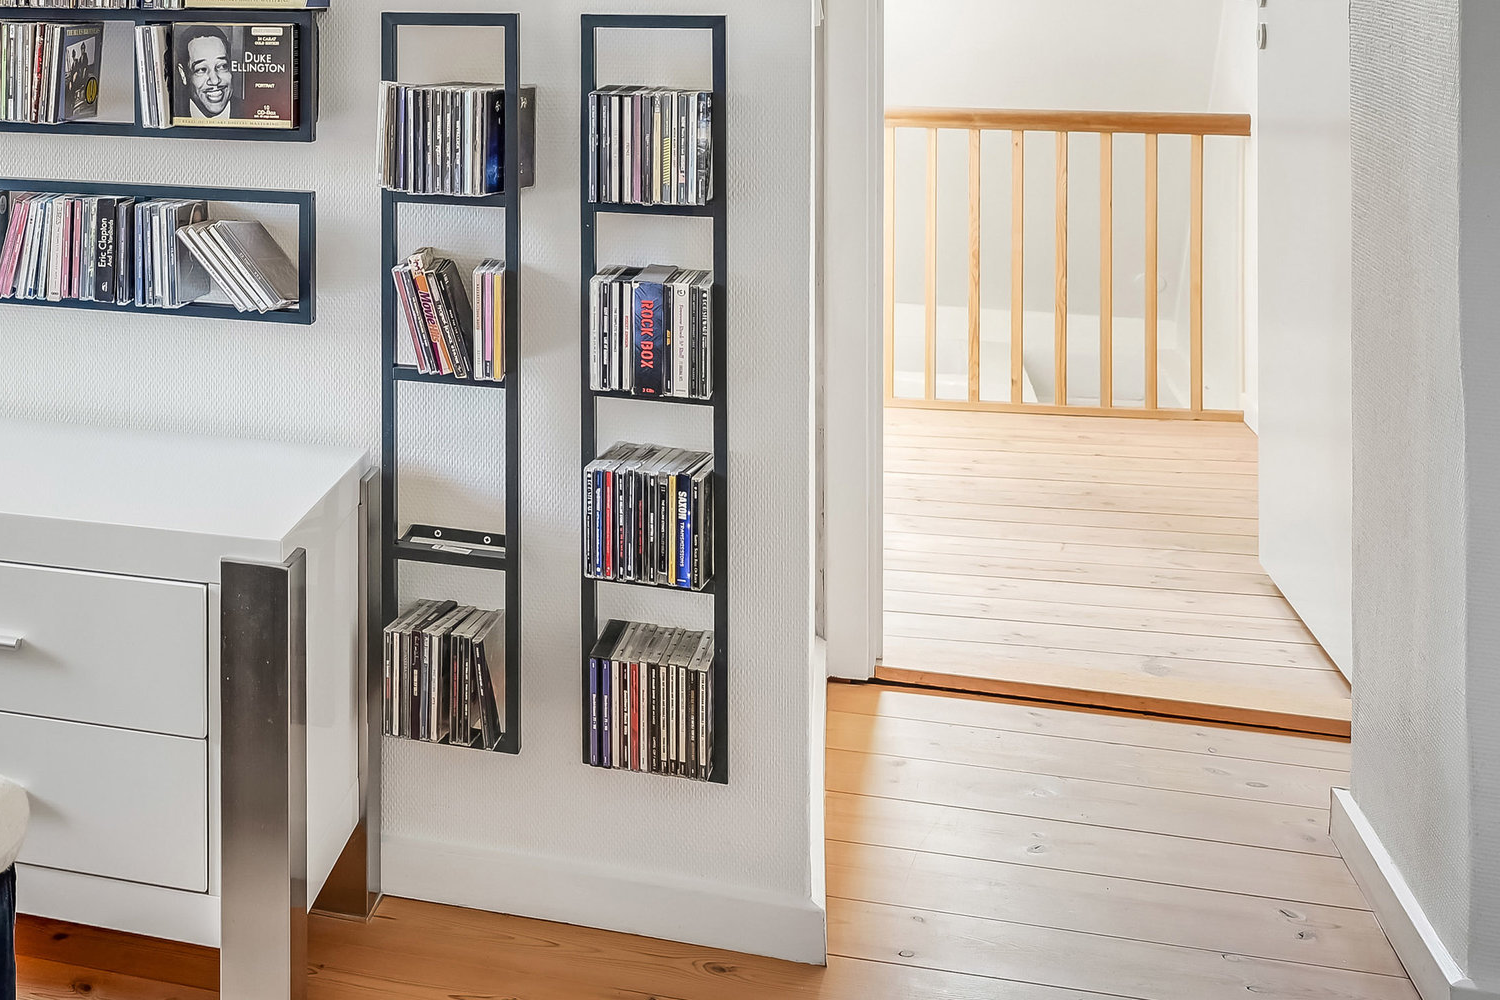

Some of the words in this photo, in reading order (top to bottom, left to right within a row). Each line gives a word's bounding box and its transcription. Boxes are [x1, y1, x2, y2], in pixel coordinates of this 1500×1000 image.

[231, 60, 285, 73] ELLINGTON
[244, 51, 271, 63] DUKE
[98, 217, 108, 249] Clapton
[98, 251, 106, 267] Eric
[640, 300, 654, 337] ROCK
[640, 340, 654, 369] BOX
[678, 490, 687, 520] SAXON
